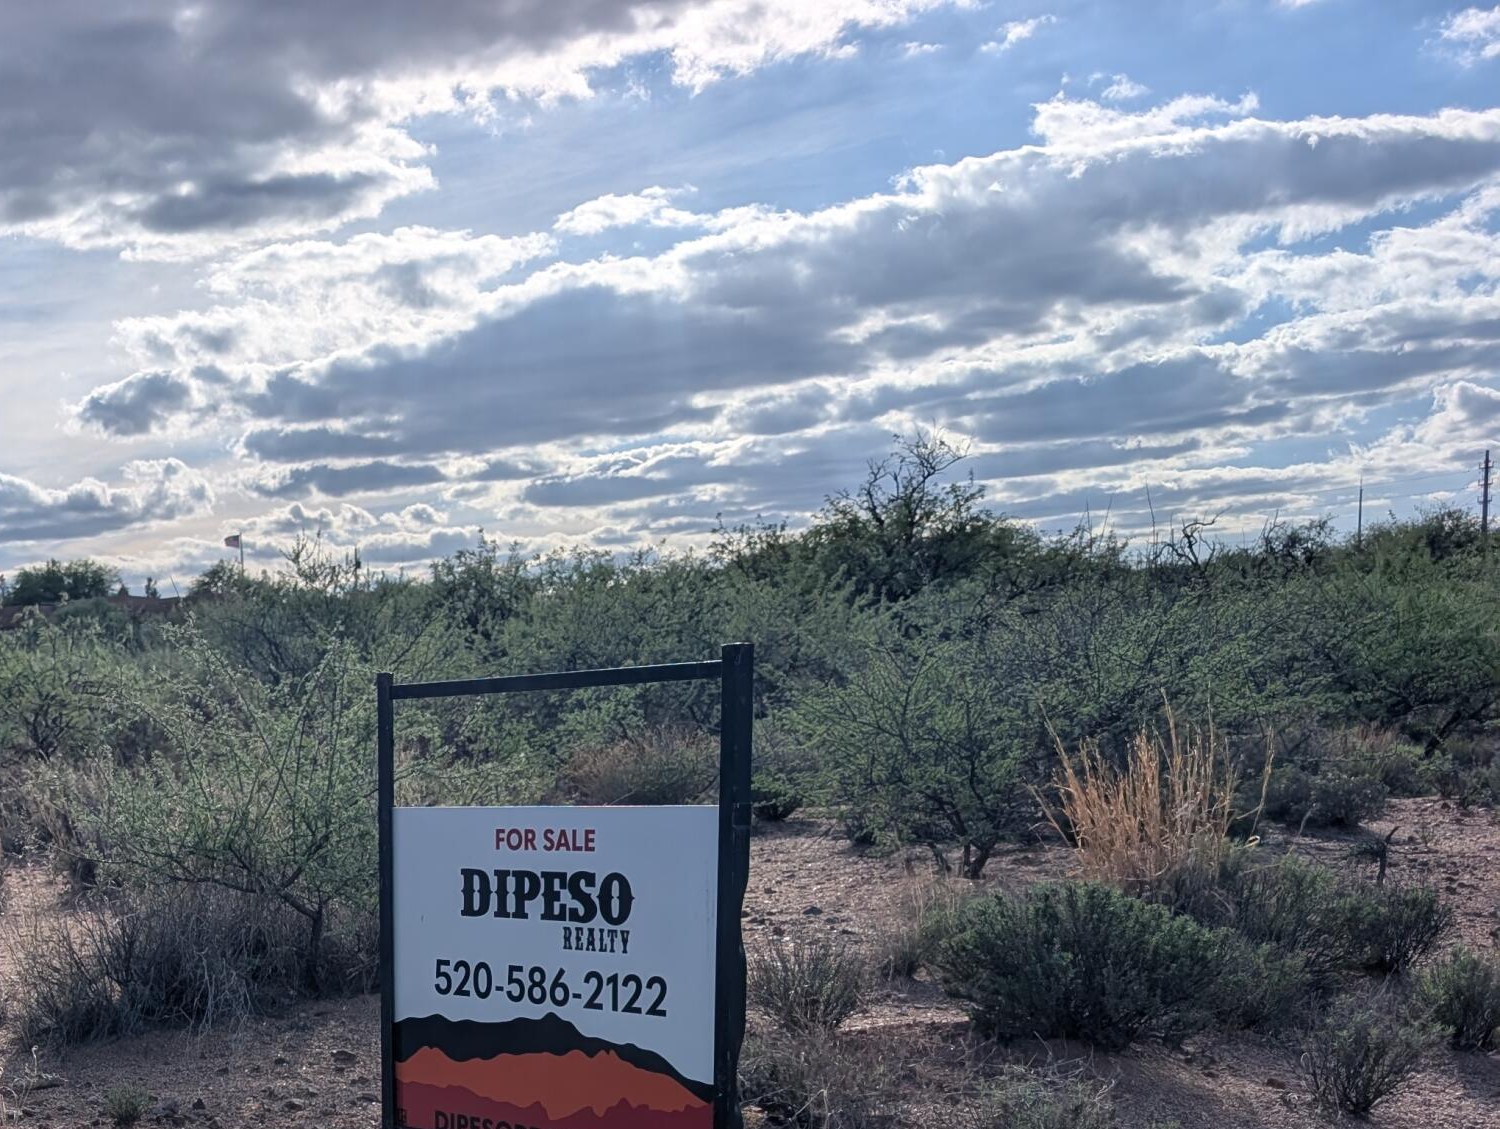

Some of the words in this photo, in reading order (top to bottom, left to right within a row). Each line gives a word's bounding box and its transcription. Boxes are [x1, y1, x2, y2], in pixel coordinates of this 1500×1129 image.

[495, 828, 537, 851] FOR
[543, 828, 596, 852] SALE
[460, 868, 635, 926] DIPESO
[562, 926, 630, 954] REALTY
[434, 958, 668, 1017] 520-586-2122
